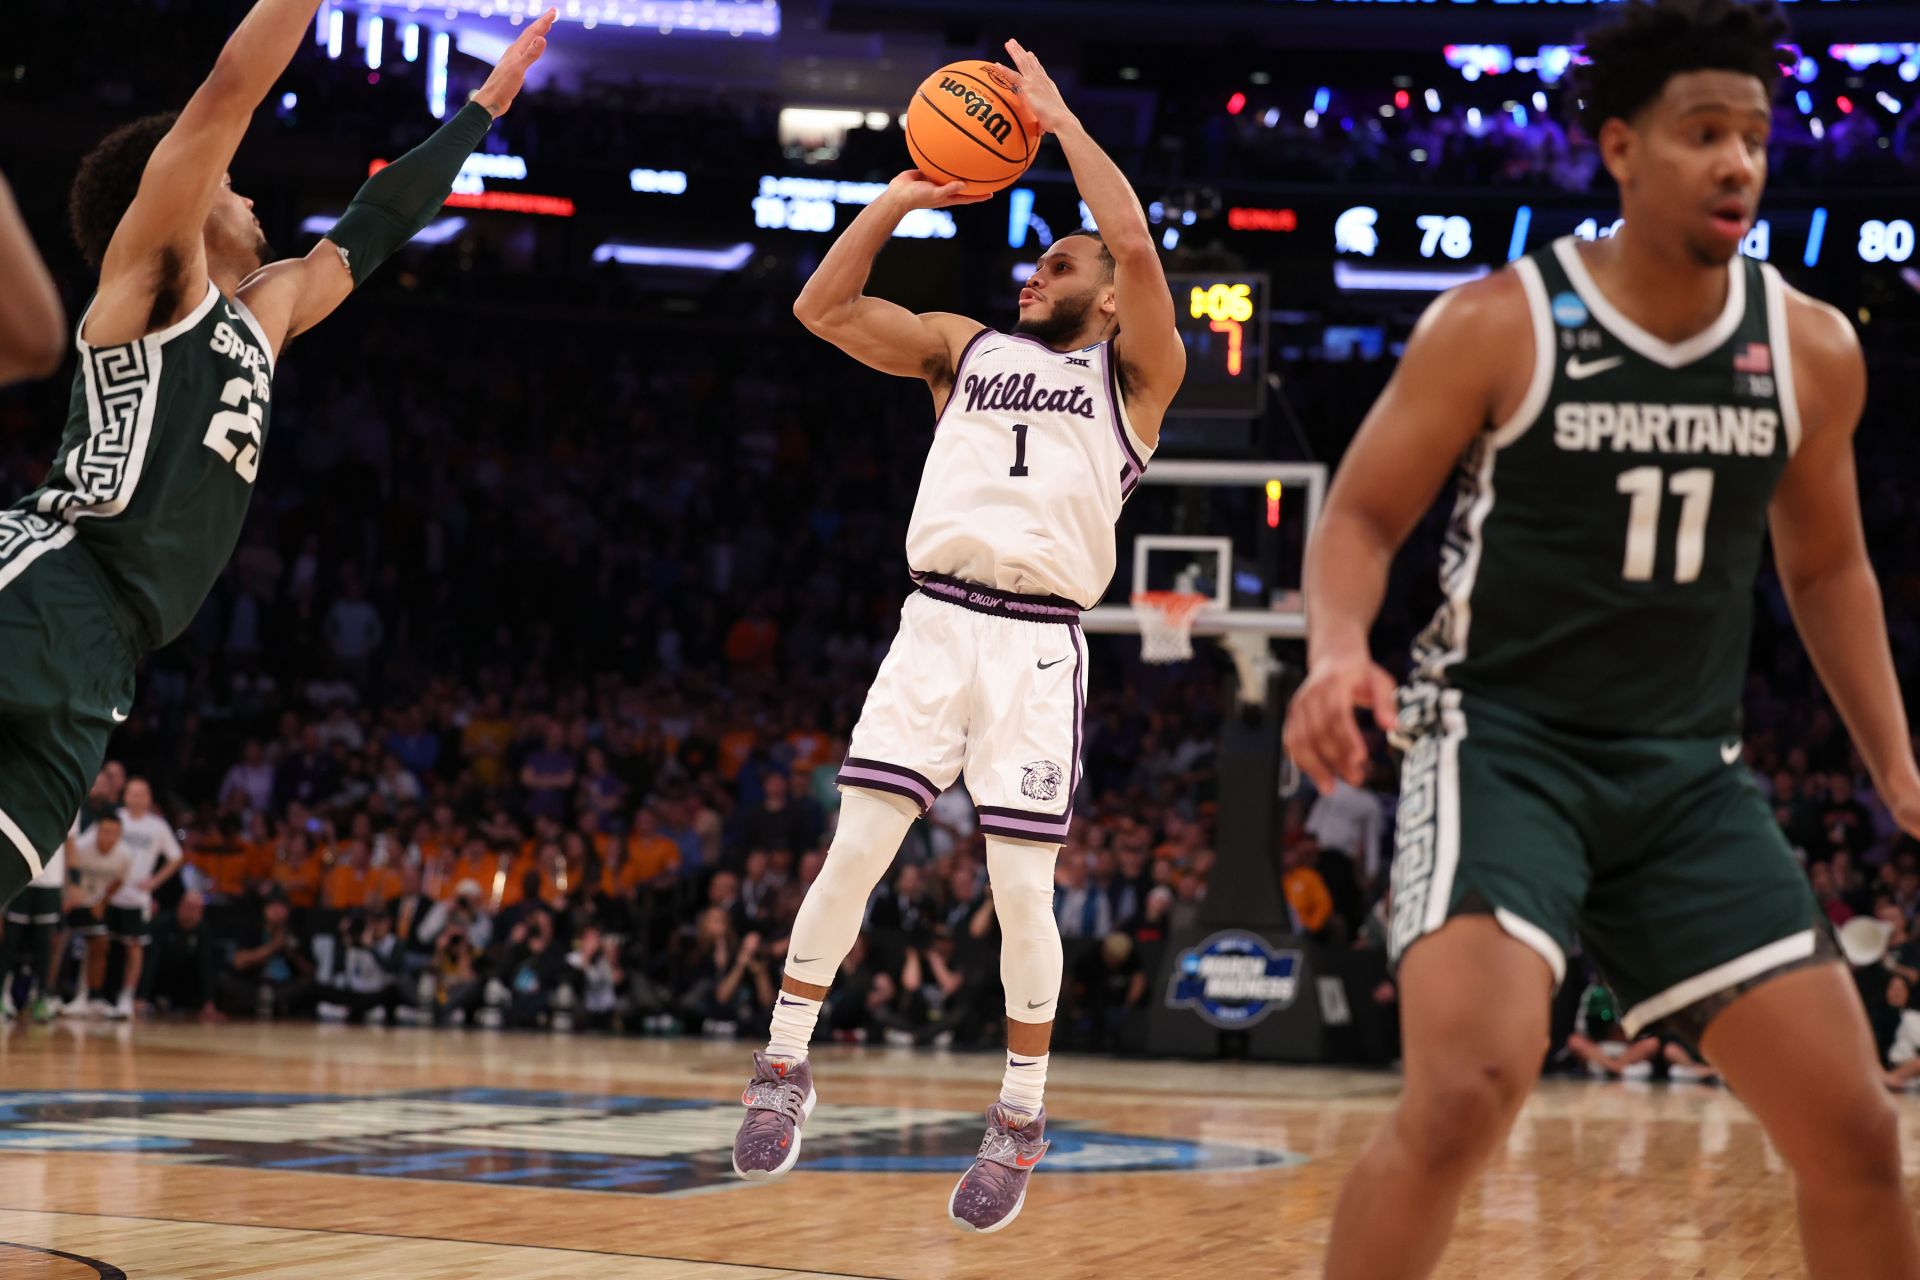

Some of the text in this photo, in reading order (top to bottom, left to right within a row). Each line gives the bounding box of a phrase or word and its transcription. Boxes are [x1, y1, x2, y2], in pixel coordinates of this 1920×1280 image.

[939, 77, 1012, 145] Wilson
[1416, 214, 1472, 259] 78
[1857, 219, 1915, 262] 80
[1209, 319, 1242, 376] 7
[964, 371, 1096, 420] Wildcats
[1009, 423, 1029, 477] 1
[1554, 402, 1778, 457] SPARTANS
[1616, 465, 1714, 584] 11
[968, 592, 1002, 608] EMAW
